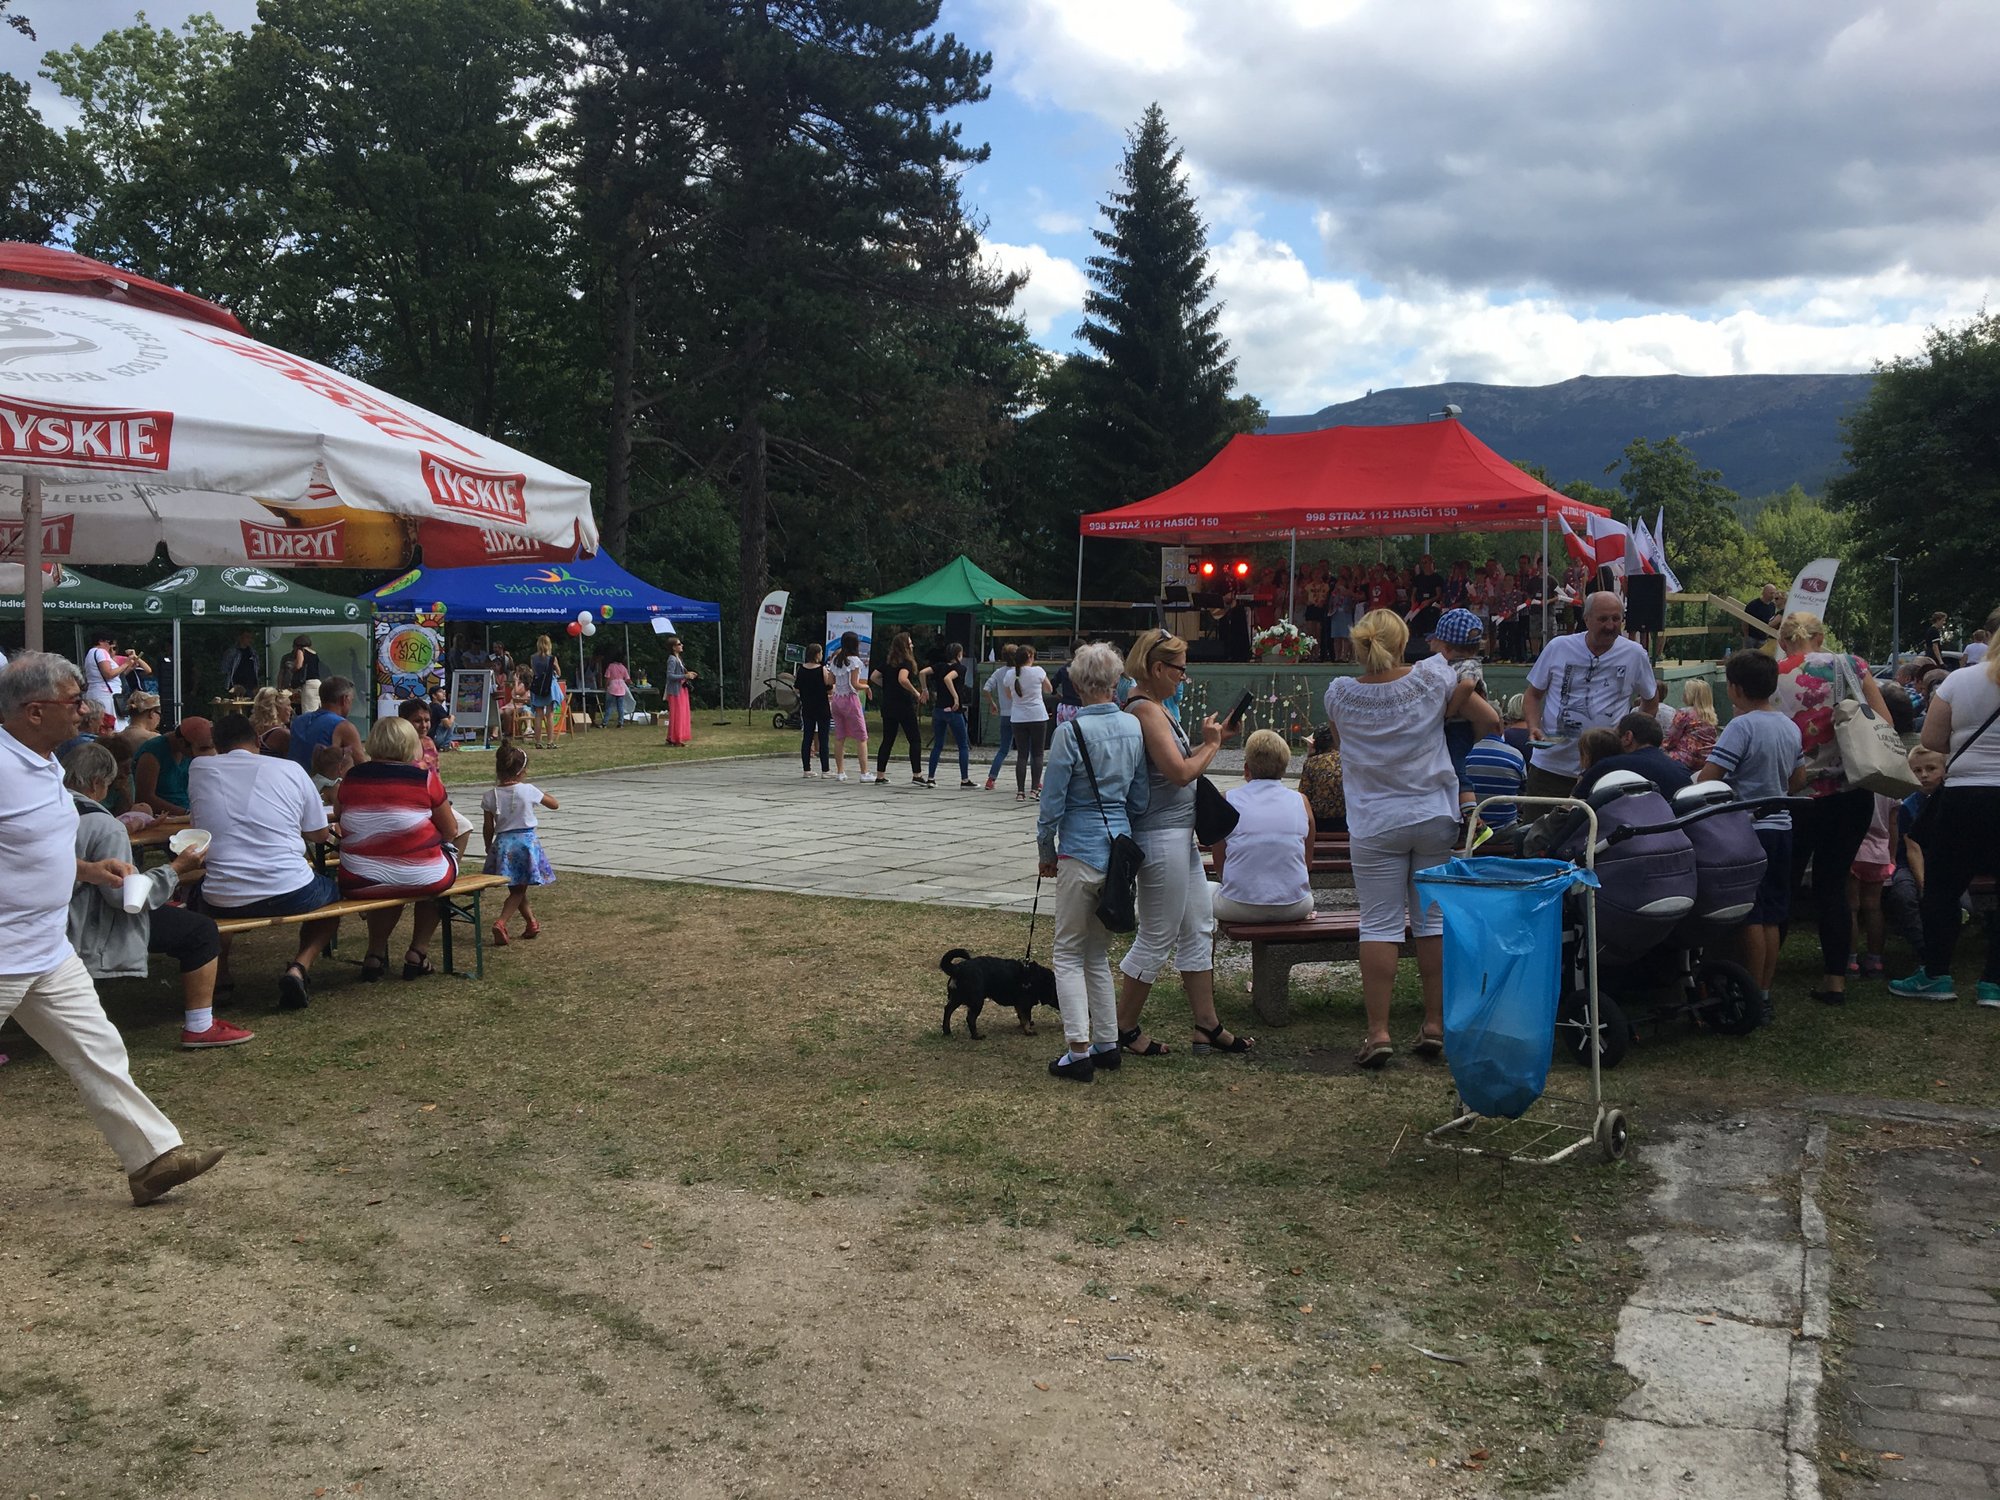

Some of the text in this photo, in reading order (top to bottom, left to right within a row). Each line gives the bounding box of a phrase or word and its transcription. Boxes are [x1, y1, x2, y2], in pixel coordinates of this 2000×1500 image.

[428, 459, 521, 516] TYSKIE
[1306, 512, 1325, 522] 998
[1328, 510, 1366, 521] STRAŻ
[1369, 511, 1390, 520] 112
[1437, 507, 1458, 517] 150
[1089, 522, 1106, 531] 998
[1109, 519, 1140, 530] STRAŻ
[1143, 520, 1161, 529] 112
[1201, 517, 1219, 527] 150
[494, 583, 633, 598] Szklarska Poręba
[0, 599, 133, 611] adleśwo Szklarska Poręba
[219, 605, 335, 616] Nadleśnictwo Szklarska Poręba
[485, 606, 568, 615] www.szklarskaporeba.pl
